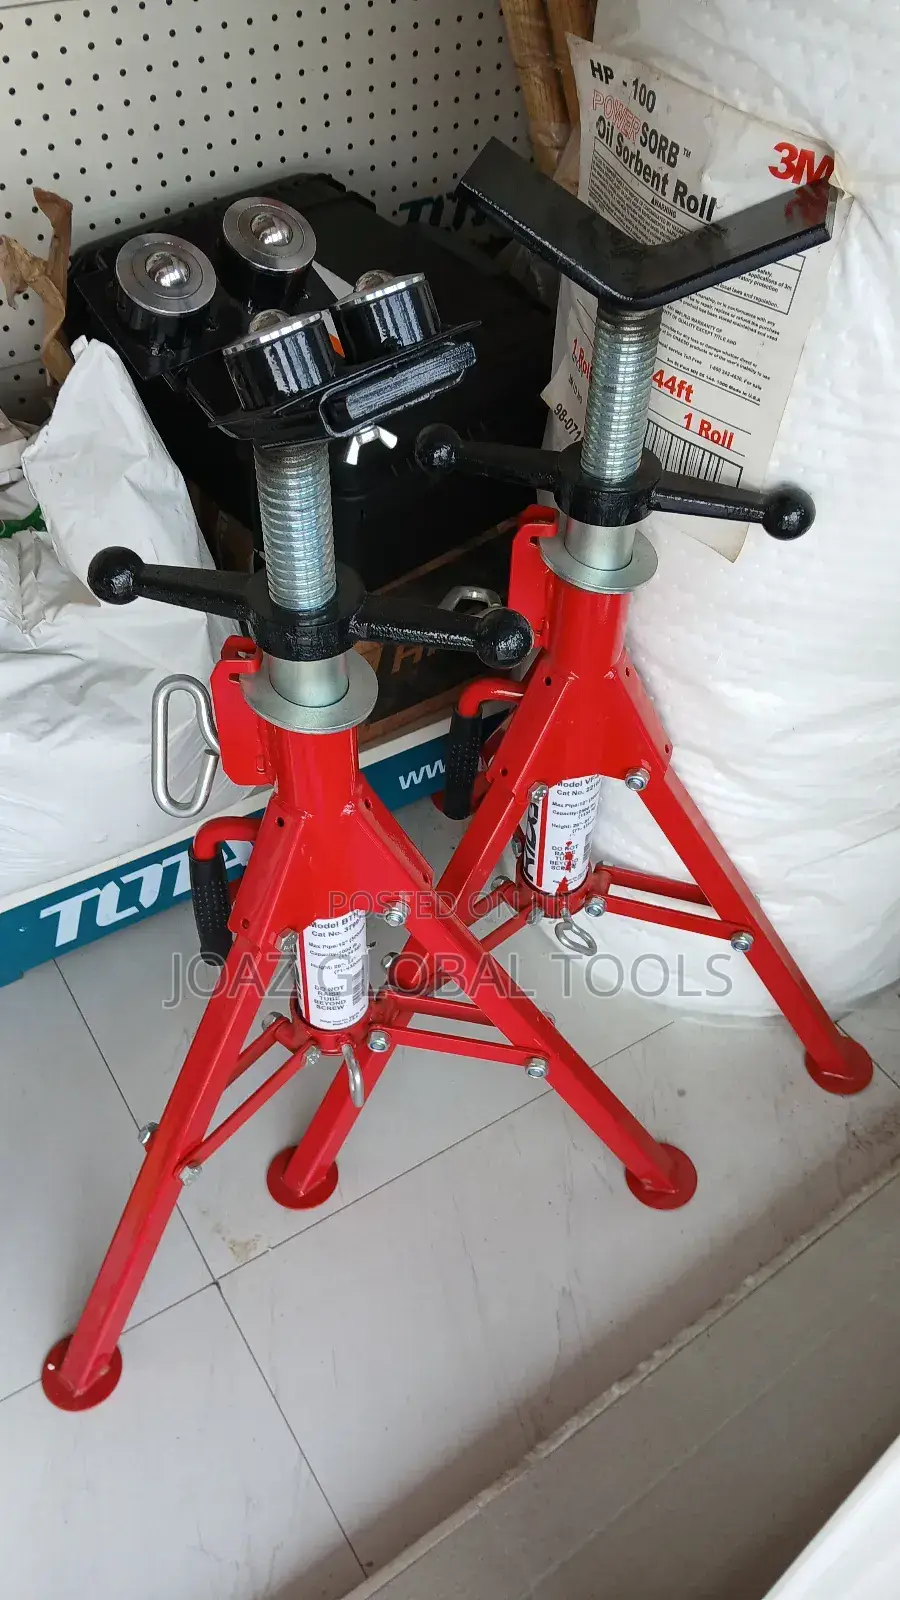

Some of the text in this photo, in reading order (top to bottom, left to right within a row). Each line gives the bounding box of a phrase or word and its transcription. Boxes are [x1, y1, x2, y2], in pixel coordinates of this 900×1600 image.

[590, 59, 615, 86] HP
[632, 77, 656, 114] 100
[596, 115, 614, 147] Oil
[615, 134, 669, 197] Sorbent
[672, 184, 717, 223] Roll
[768, 142, 835, 185] 3M
[753, 281, 779, 293] protection
[677, 317, 697, 330] QUALITY
[553, 402, 583, 442] 98-071
[683, 412, 735, 451] 1 Roll
[311, 921, 340, 929] Model
